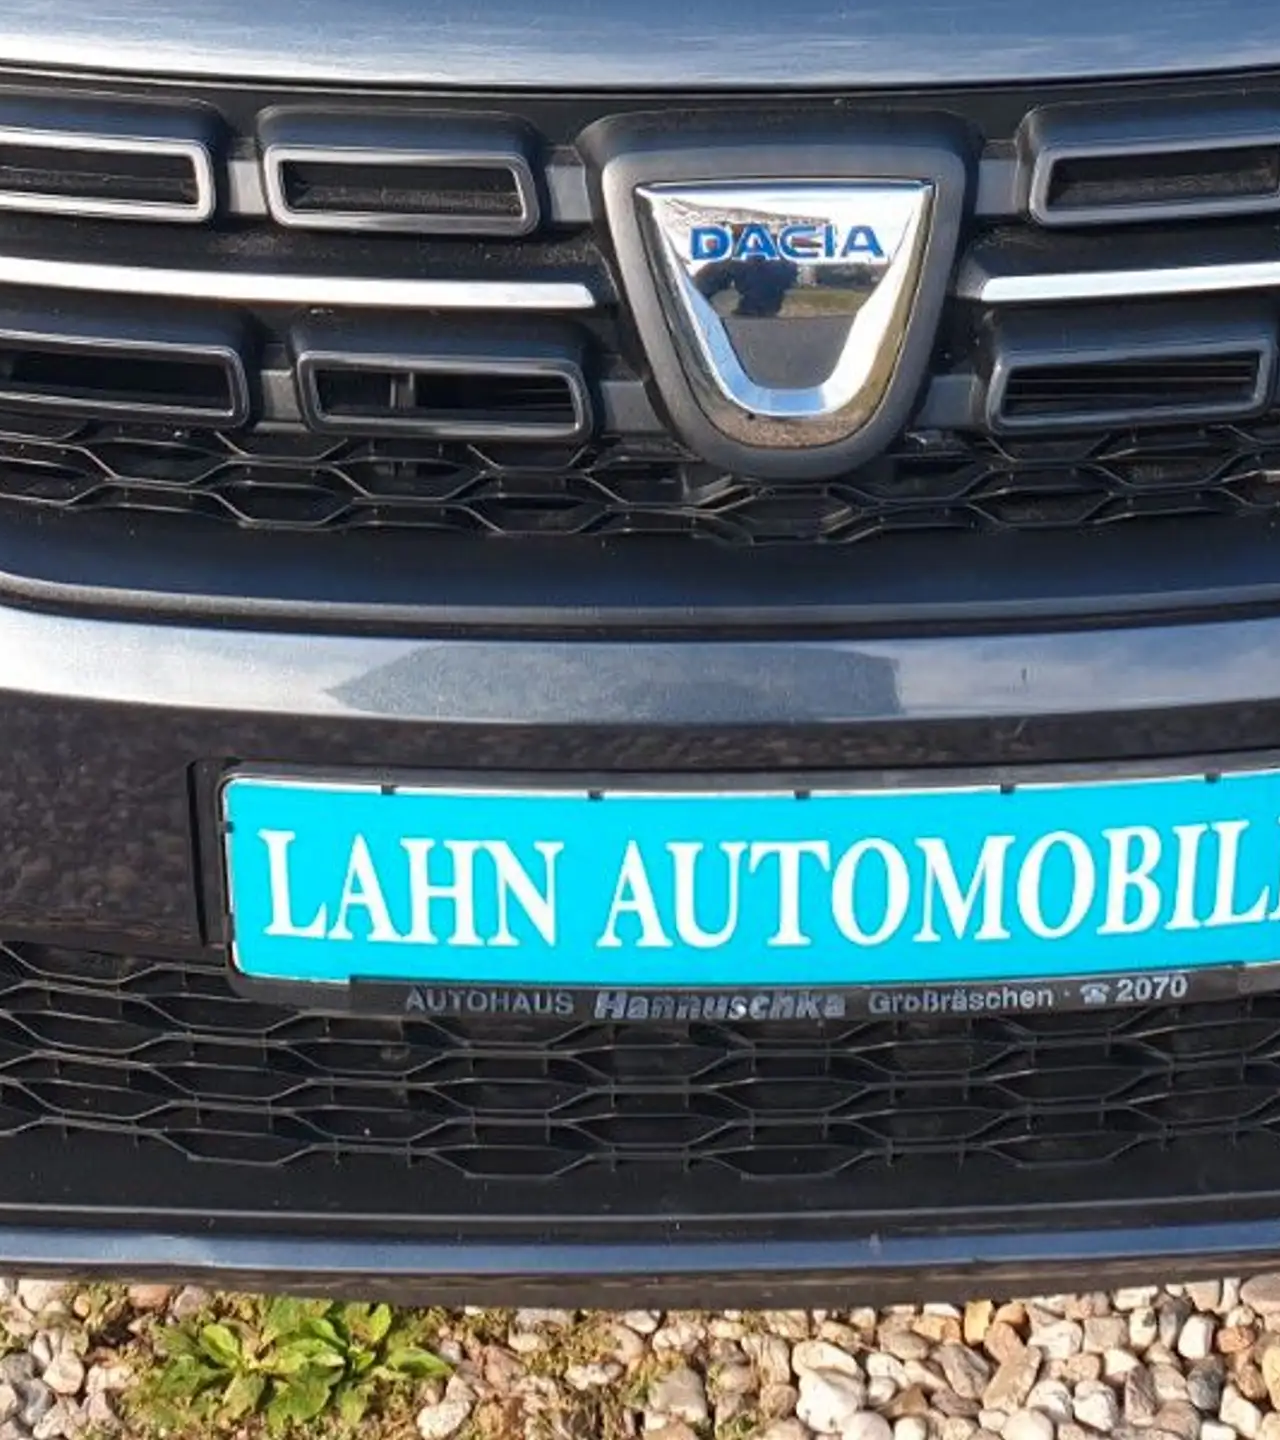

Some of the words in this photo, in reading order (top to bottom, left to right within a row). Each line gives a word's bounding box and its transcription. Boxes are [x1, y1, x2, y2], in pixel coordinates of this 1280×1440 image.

[690, 224, 884, 260] DACIA
[257, 829, 564, 947] LAHN
[406, 987, 575, 1015] AUTOHAUS
[594, 991, 846, 1021] Hannuschka
[868, 987, 1054, 1015] Großräschen
[1116, 975, 1188, 1002] 2070
